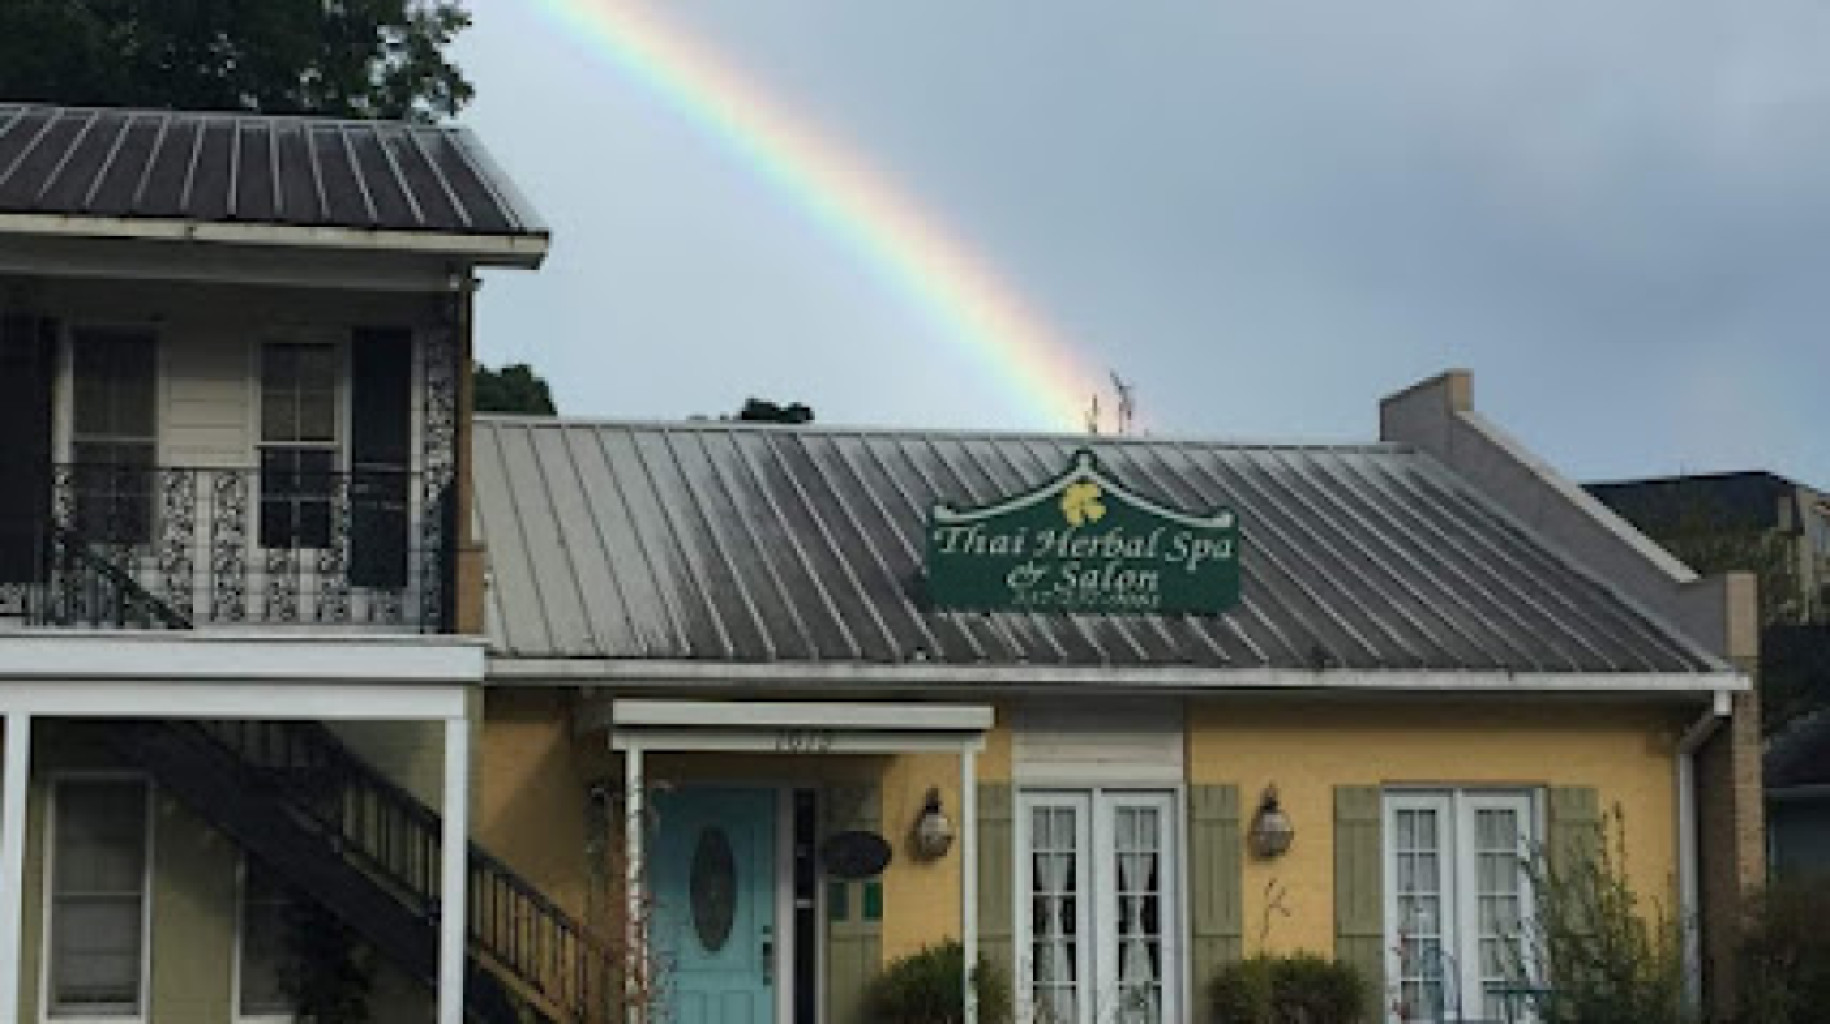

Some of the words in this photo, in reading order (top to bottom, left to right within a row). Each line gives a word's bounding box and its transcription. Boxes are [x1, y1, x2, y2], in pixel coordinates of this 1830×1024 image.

[934, 524, 1027, 554] Thai
[1032, 526, 1166, 558] Herbal
[1165, 531, 1233, 574] Spa
[1007, 561, 1047, 588] &
[1054, 560, 1159, 592] Salon
